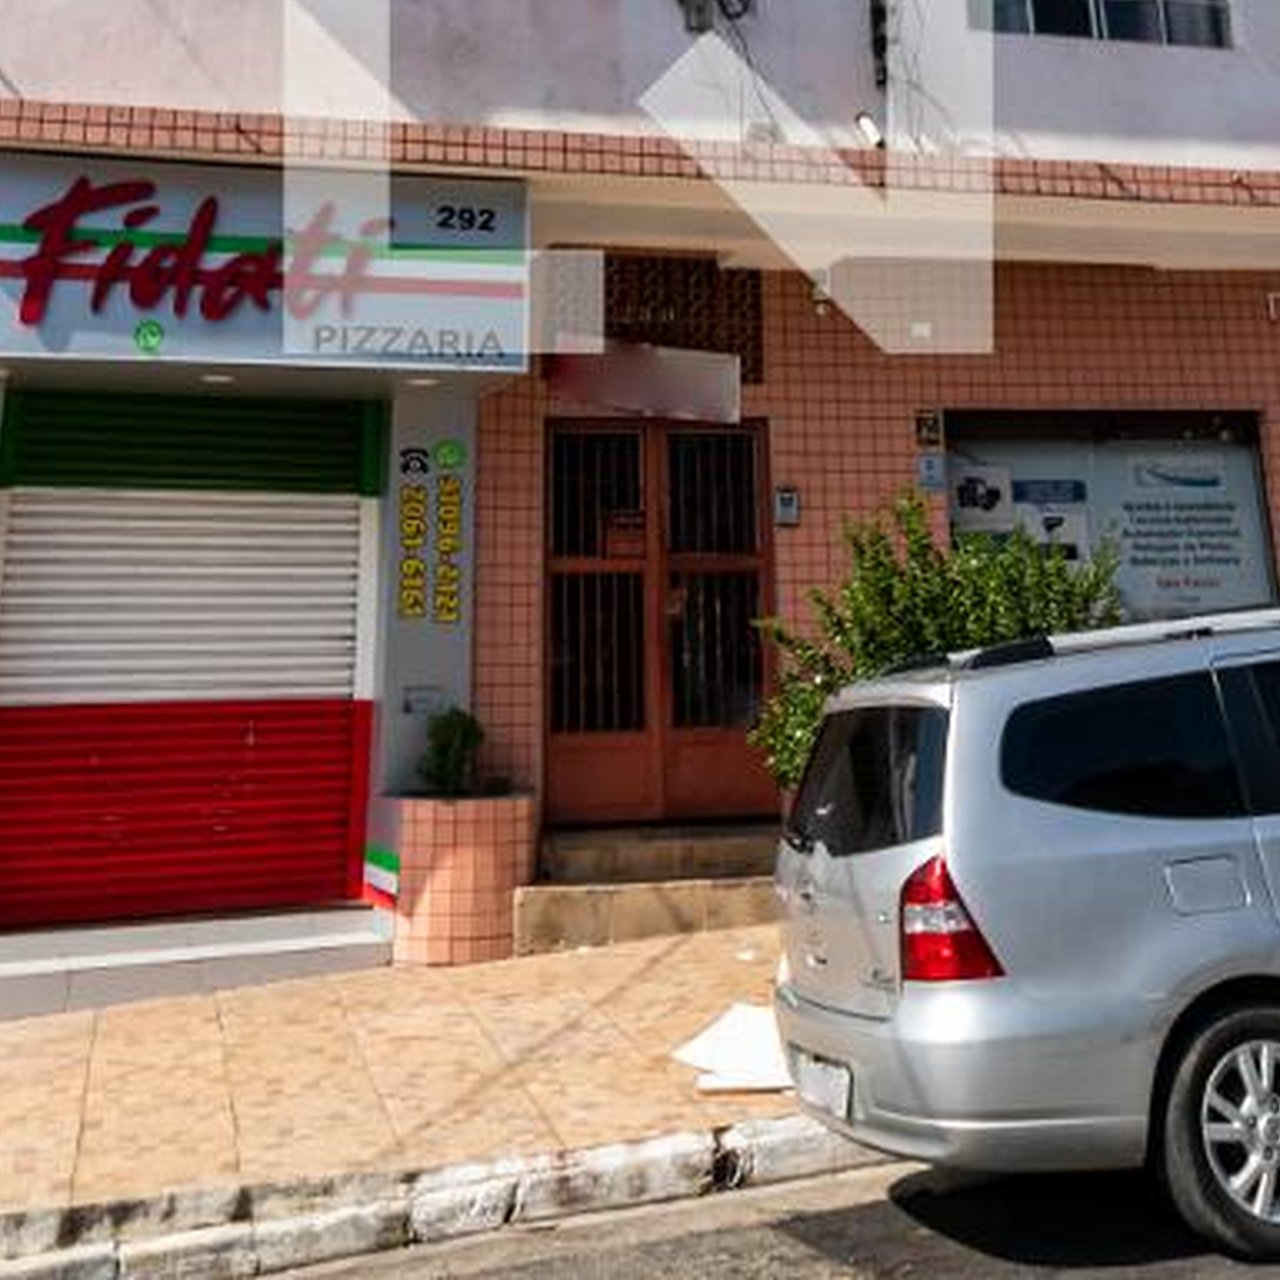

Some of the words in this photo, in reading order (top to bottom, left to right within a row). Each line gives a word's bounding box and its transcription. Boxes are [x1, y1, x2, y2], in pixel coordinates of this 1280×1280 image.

[436, 204, 497, 233] 292
[20, 175, 395, 325] Fidati
[313, 325, 506, 359] PIZZARIA
